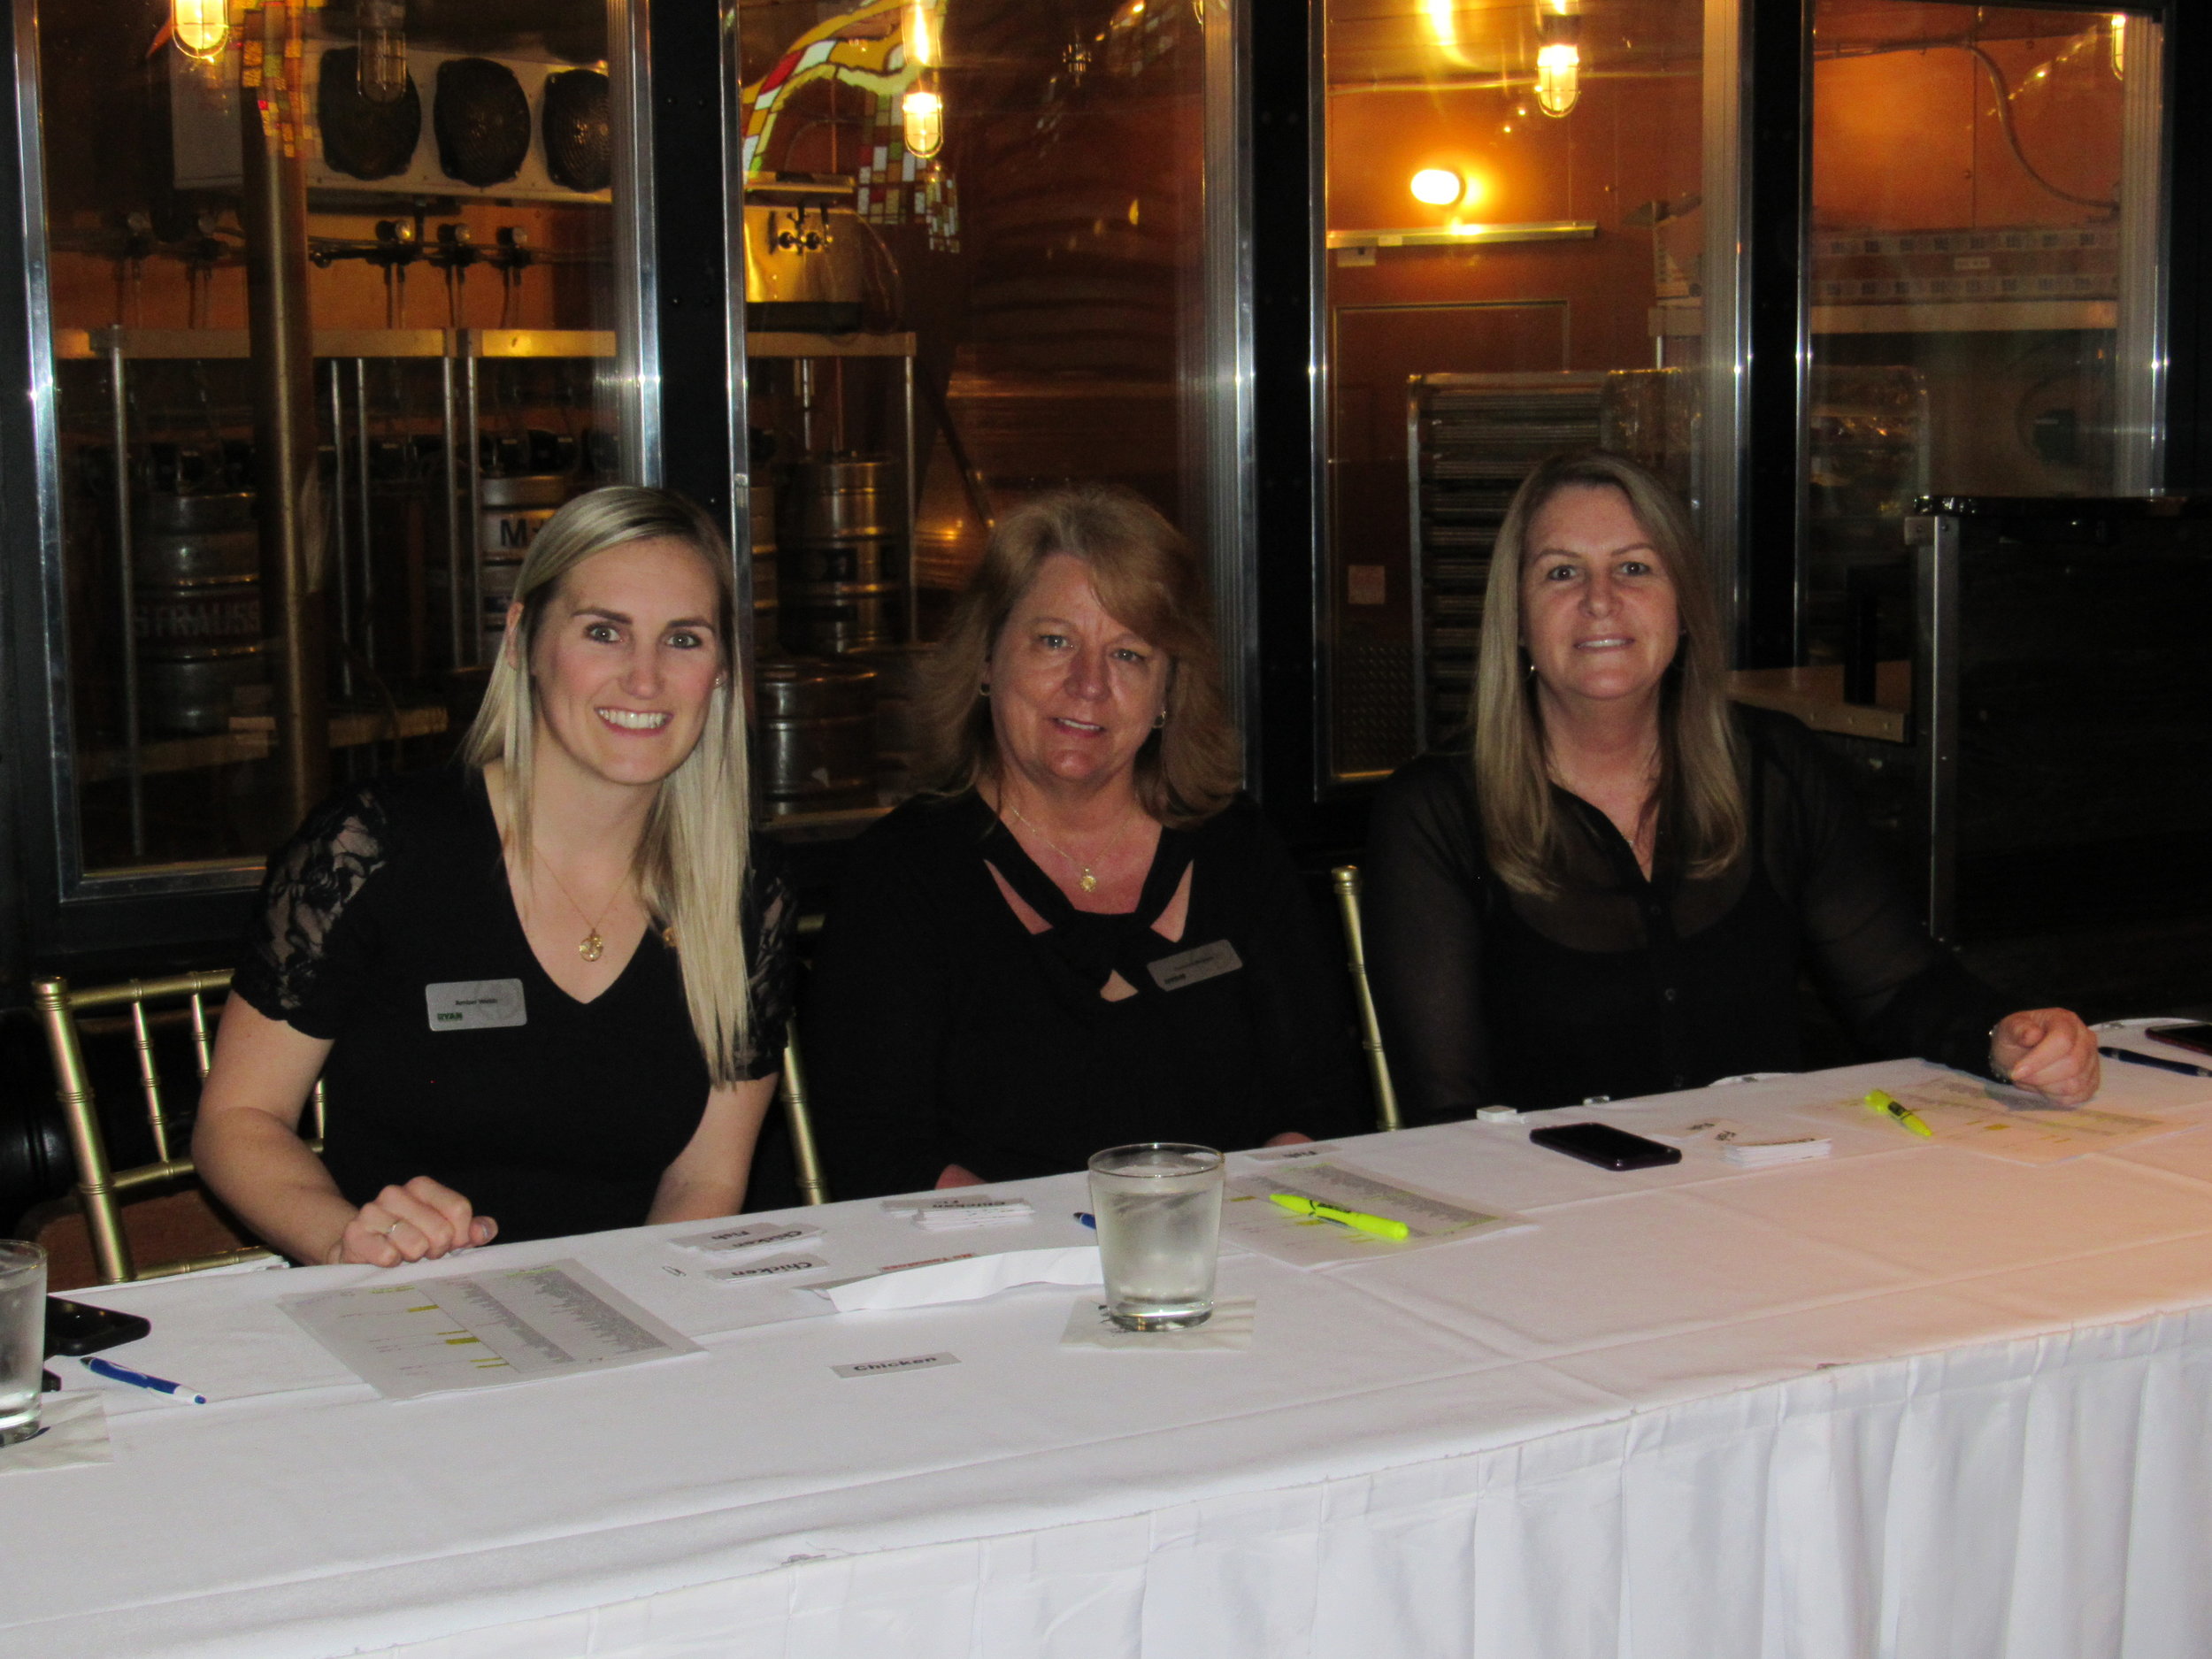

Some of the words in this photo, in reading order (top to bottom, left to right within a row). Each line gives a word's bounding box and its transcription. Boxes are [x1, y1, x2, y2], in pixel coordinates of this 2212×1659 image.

[732, 1231, 803, 1248] Chicken
[731, 1262, 813, 1277] Chicken
[853, 1356, 938, 1371] Chicken
